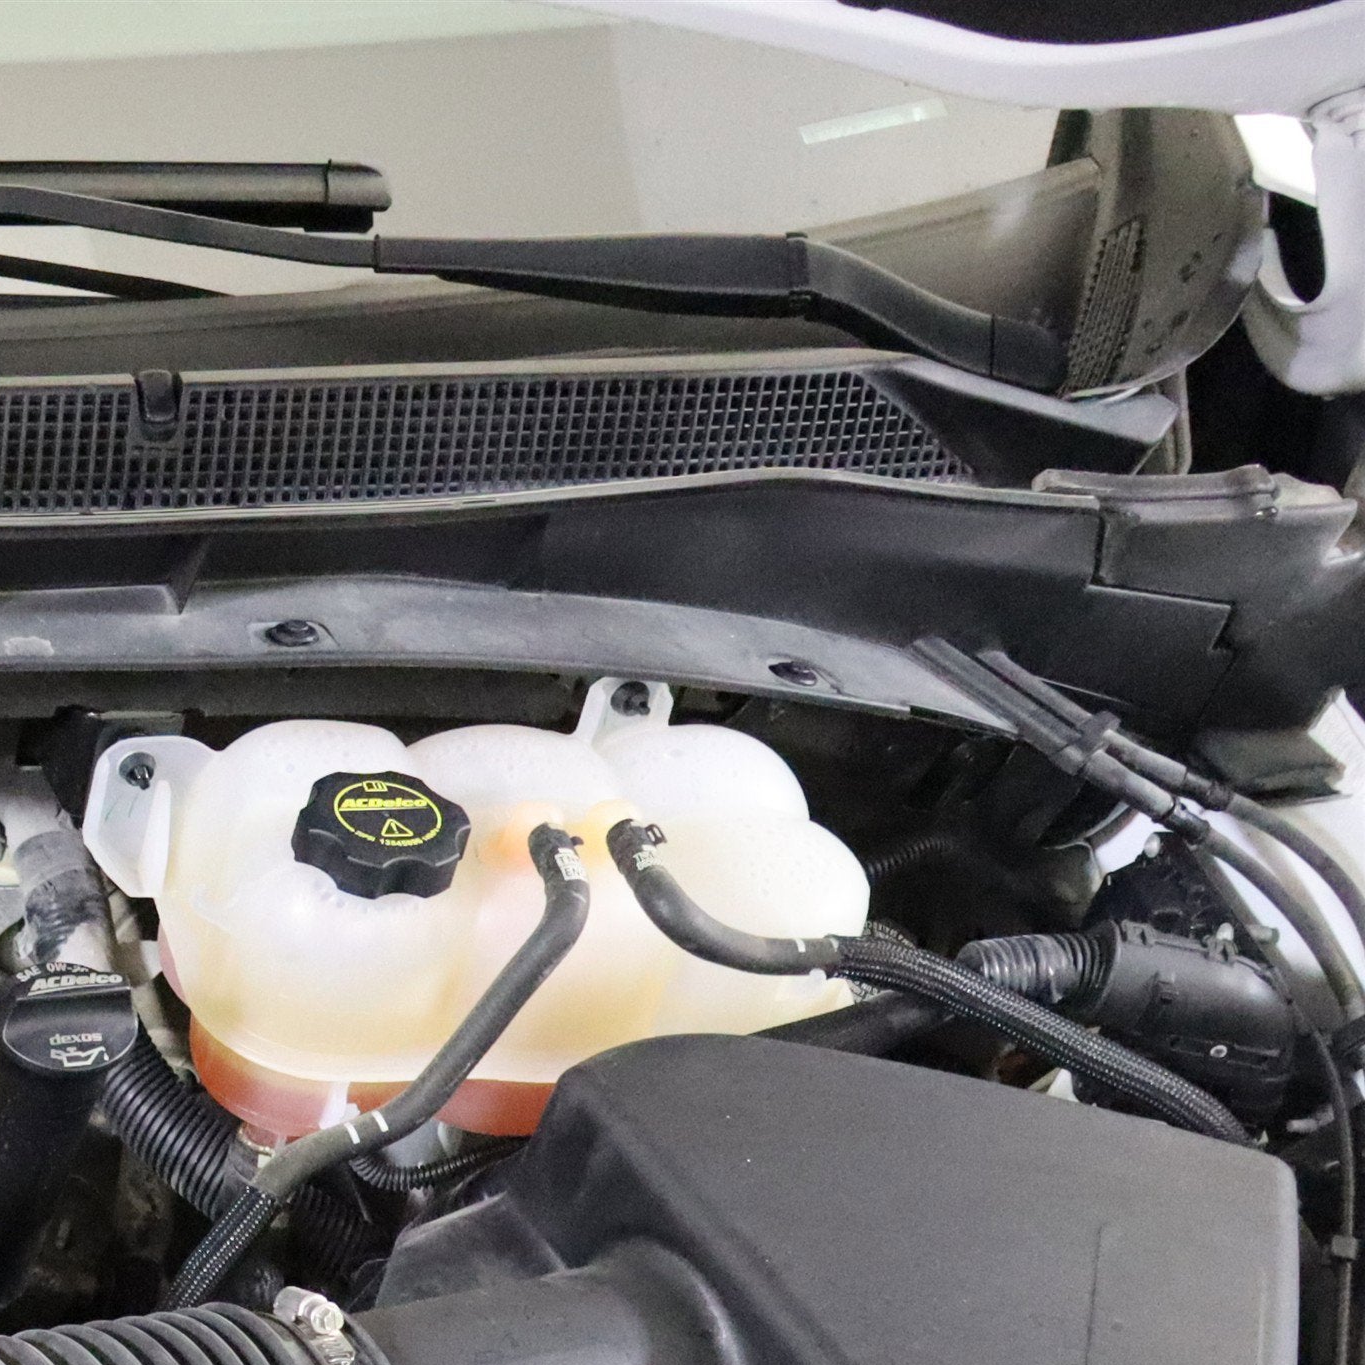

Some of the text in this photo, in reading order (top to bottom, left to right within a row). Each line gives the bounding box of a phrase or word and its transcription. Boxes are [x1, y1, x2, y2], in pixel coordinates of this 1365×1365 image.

[341, 797, 429, 809] ACDelco
[16, 965, 42, 982] SAE
[30, 973, 123, 991] ACDelco
[49, 1032, 103, 1046] dexos
